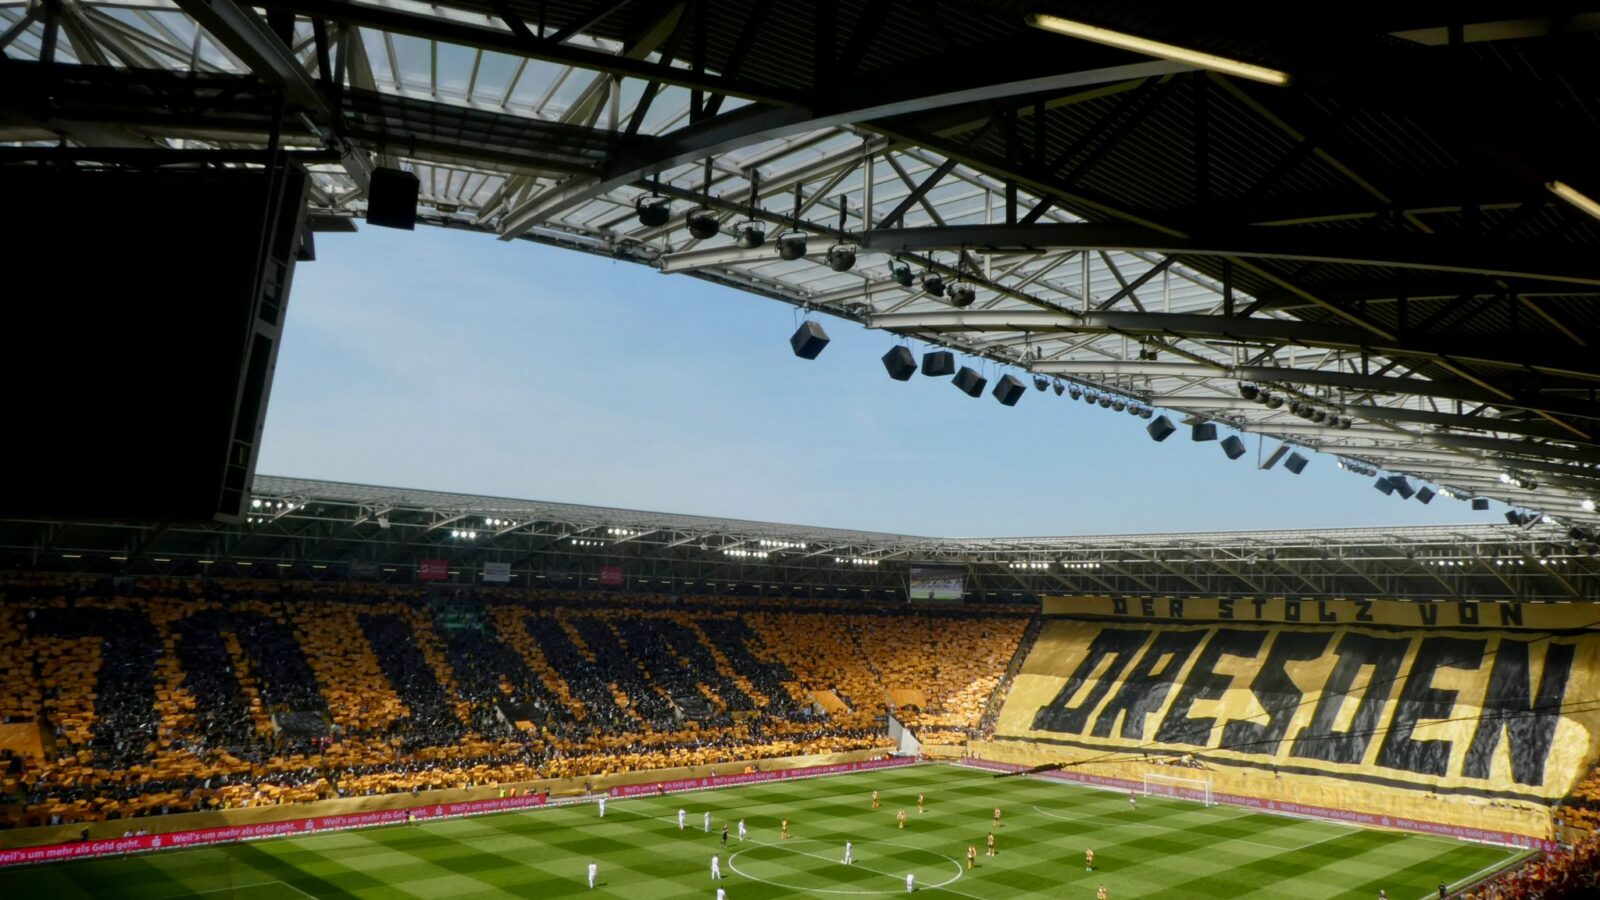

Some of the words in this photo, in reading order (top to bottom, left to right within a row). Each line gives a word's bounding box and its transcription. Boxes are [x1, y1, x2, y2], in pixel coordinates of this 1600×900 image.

[1113, 599, 1183, 617] DER
[1218, 599, 1374, 622] STOLZ
[1418, 602, 1524, 626] VON
[1031, 627, 1576, 787] DRESDEN
[323, 817, 347, 826] Weil's
[361, 813, 380, 822] mehr
[393, 809, 408, 818] Gel
[172, 832, 200, 843] Weil's
[217, 828, 240, 838] mehr
[241, 826, 254, 835] als
[255, 823, 274, 833] Geld
[28, 851, 44, 859] um
[46, 847, 73, 858] mehr
[75, 844, 91, 854] als
[92, 841, 115, 852] Geld
